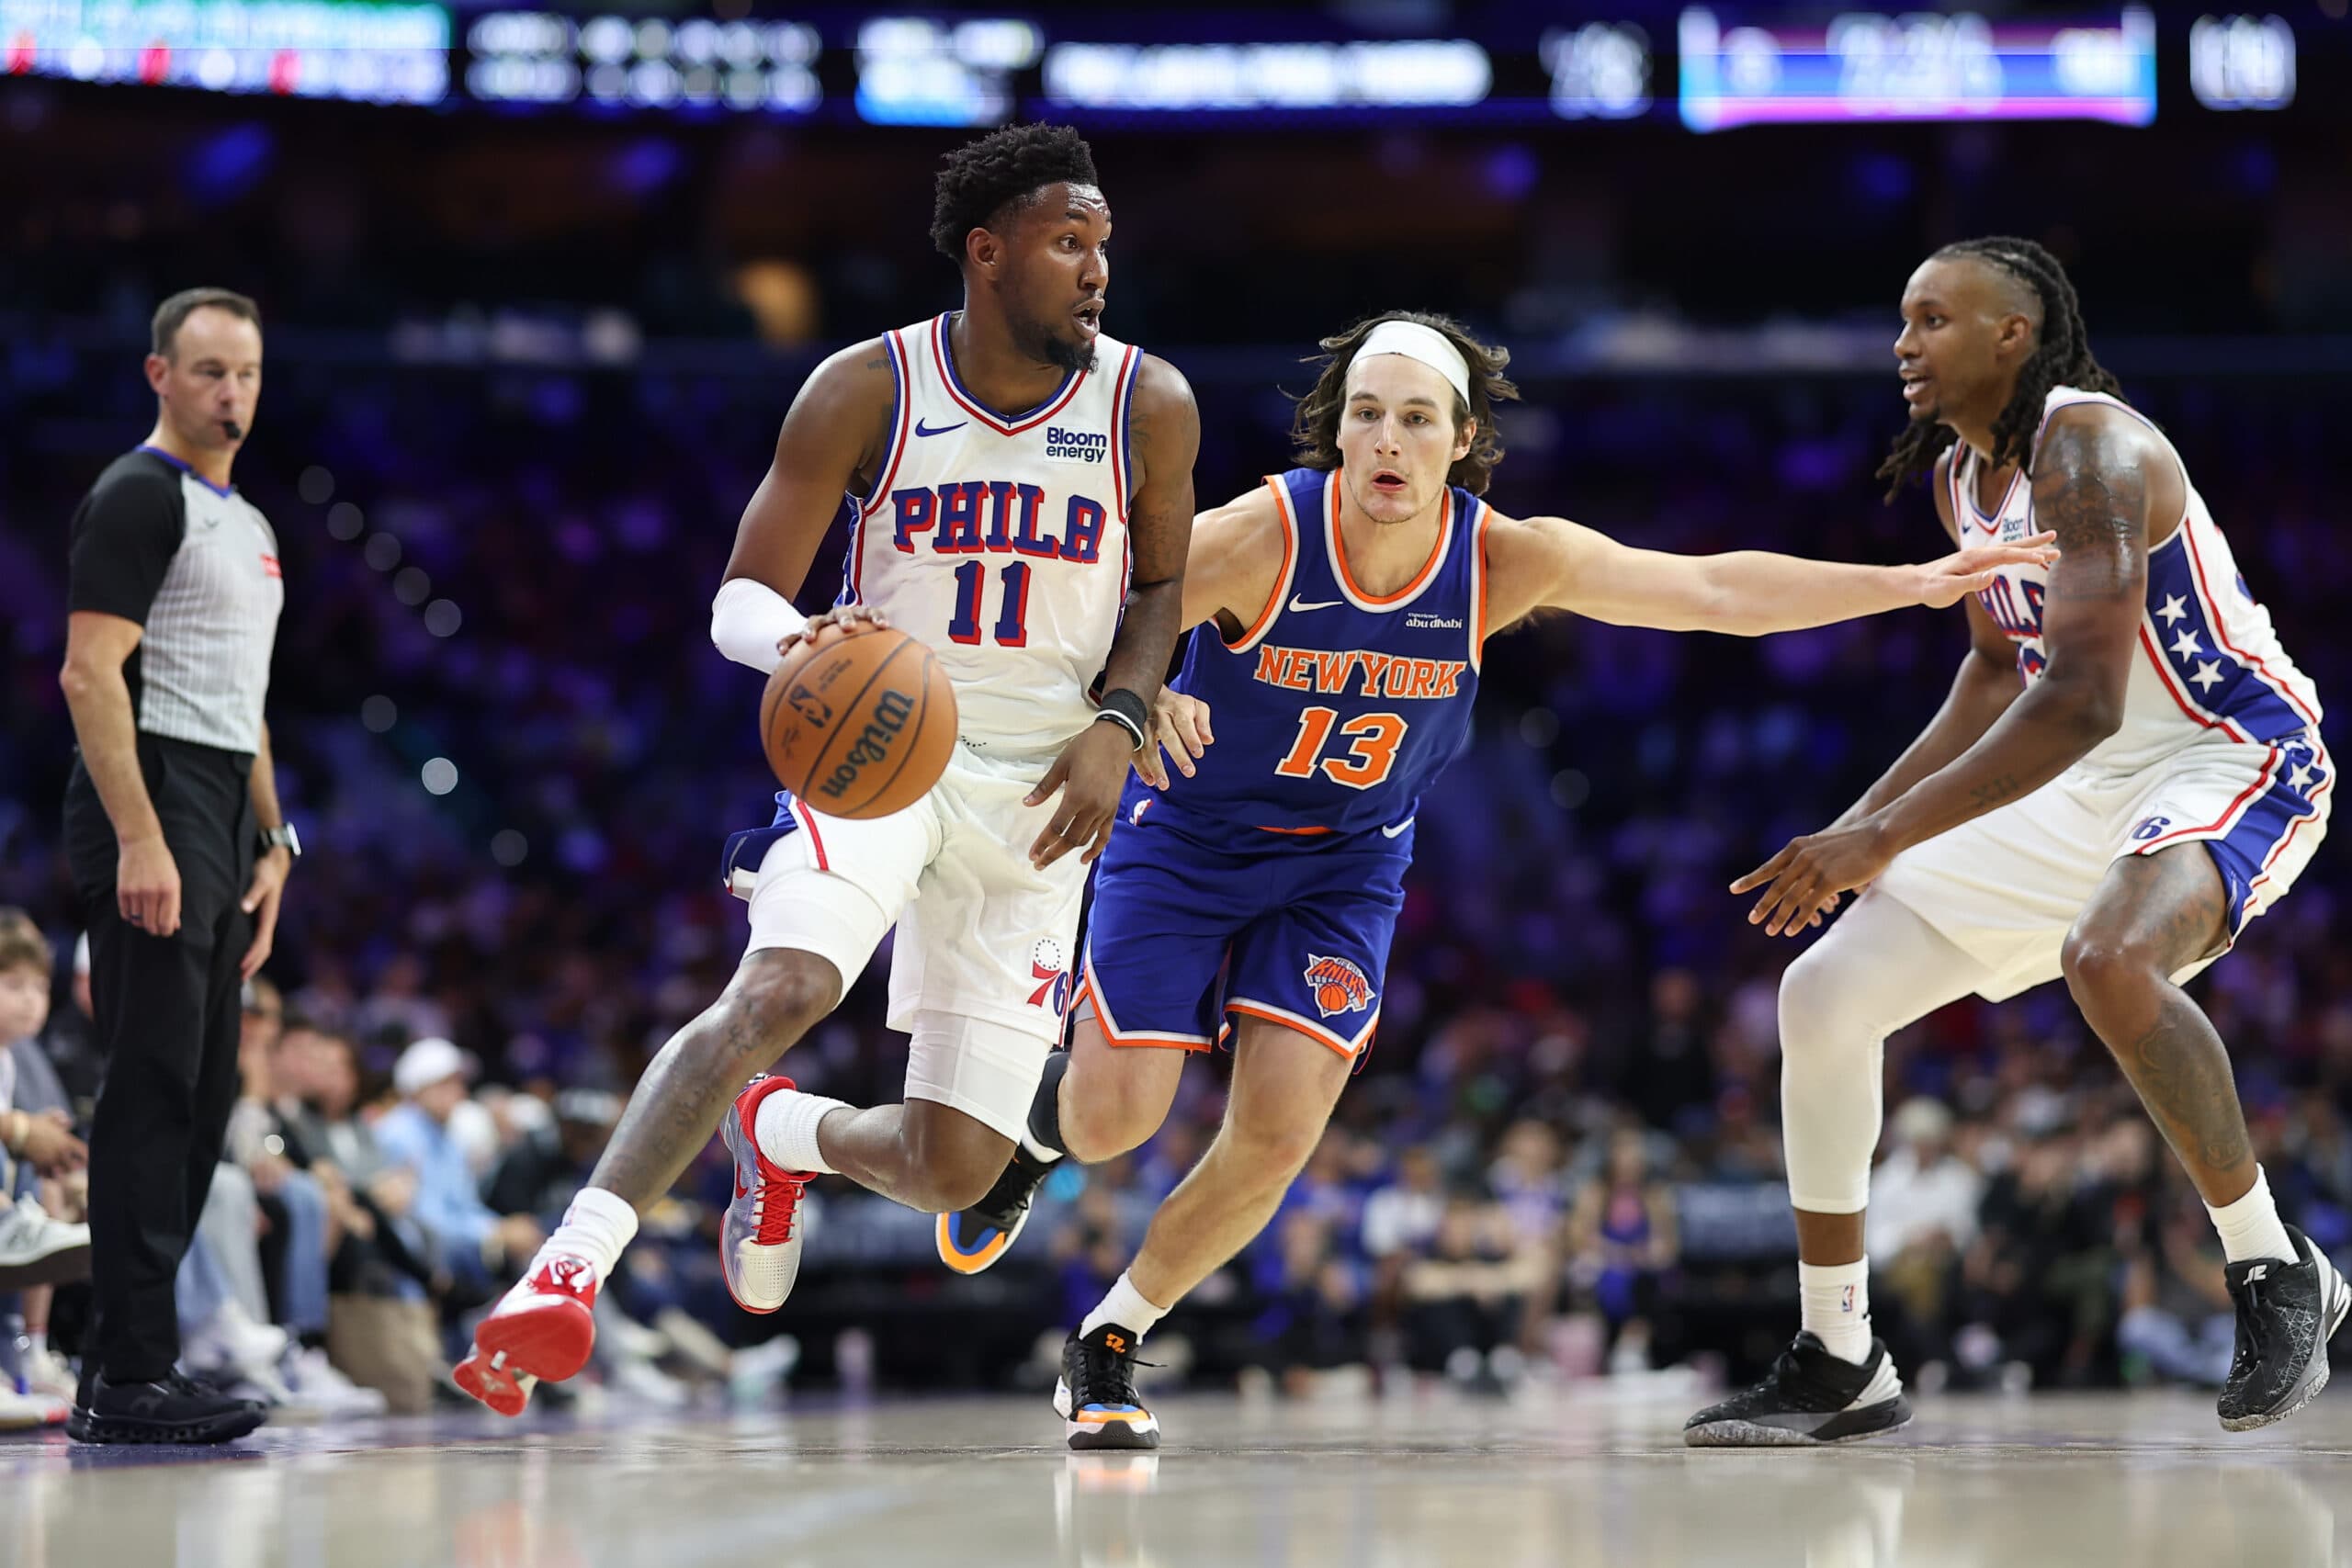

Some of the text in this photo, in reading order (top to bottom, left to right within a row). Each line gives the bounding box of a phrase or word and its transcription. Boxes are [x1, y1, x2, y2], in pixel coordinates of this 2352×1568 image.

[1046, 446, 1106, 463] energy
[1047, 426, 1107, 447] Bloom
[891, 480, 1107, 564] PHILA
[948, 560, 1031, 648] 11
[1406, 618, 1463, 629] abu dhabi
[1253, 643, 1468, 698] NEW YORK
[820, 688, 914, 799] Wilson
[1274, 705, 1408, 790] 13
[2132, 816, 2171, 840] 6
[1307, 959, 1365, 1008] KNICKS
